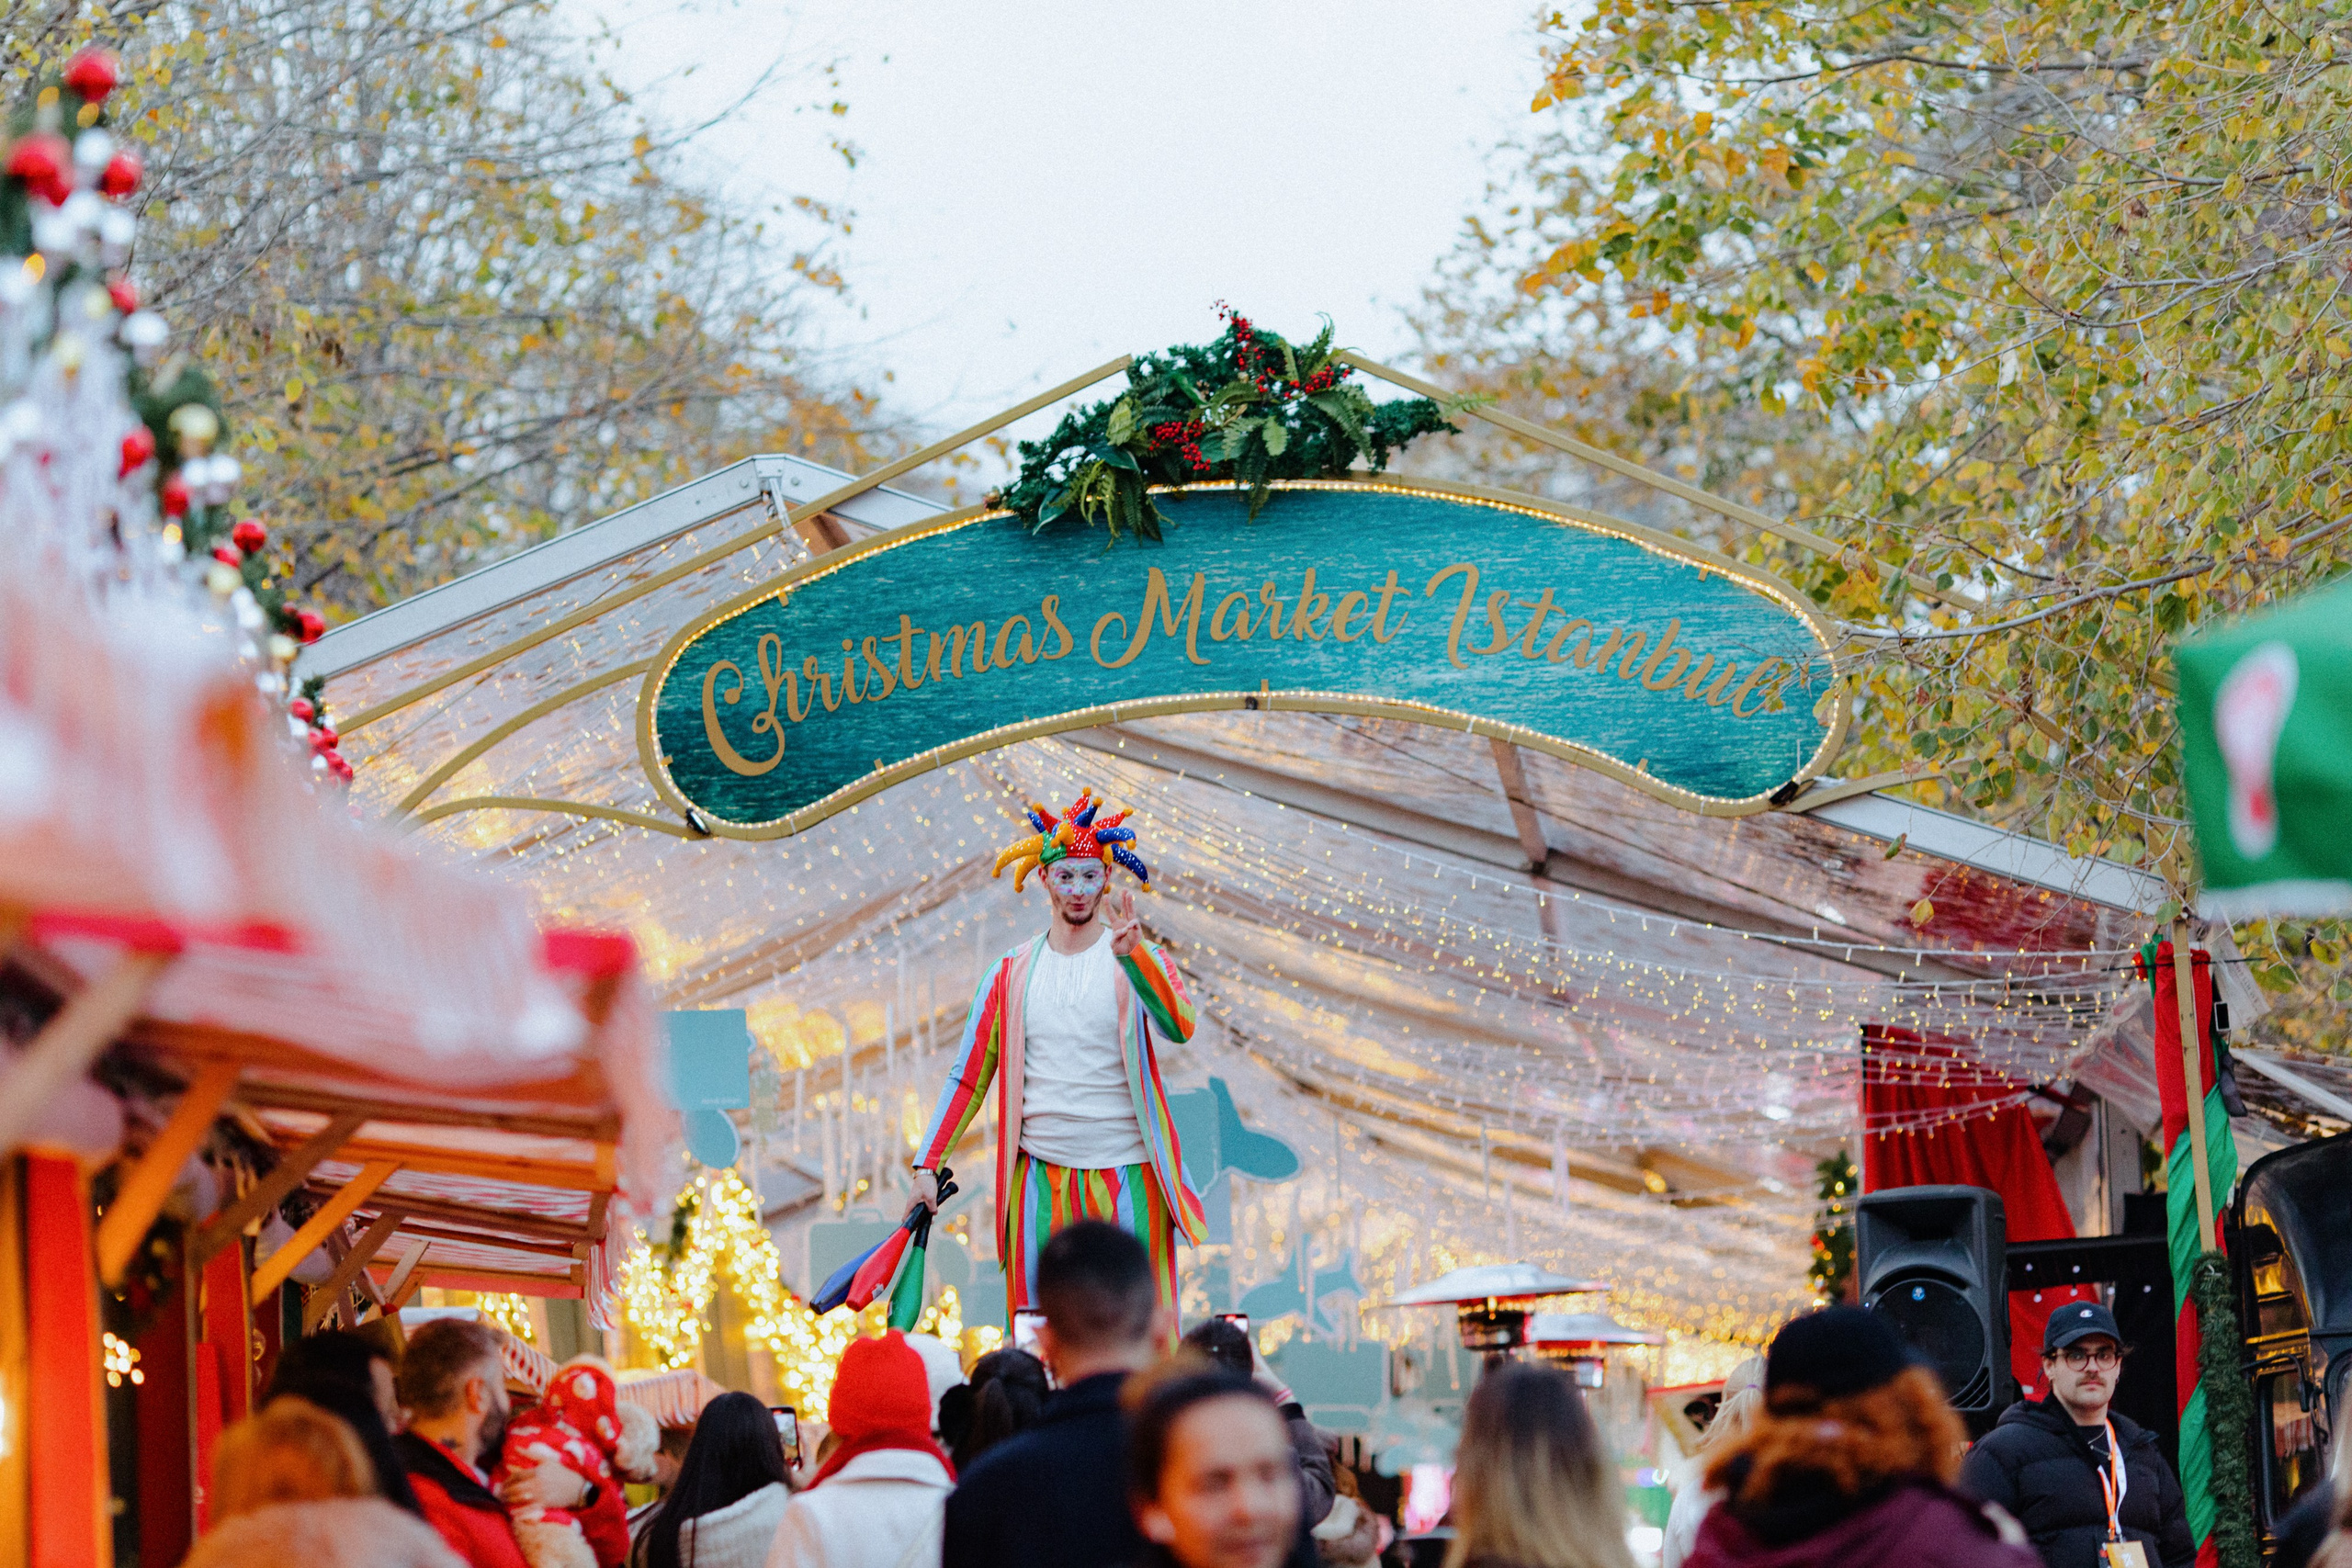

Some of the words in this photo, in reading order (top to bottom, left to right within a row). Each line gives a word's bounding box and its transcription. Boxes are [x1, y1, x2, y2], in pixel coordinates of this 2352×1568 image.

[702, 594, 1074, 776] Christmas
[1091, 567, 1411, 669] Market
[1426, 562, 1784, 718] Istanbul
